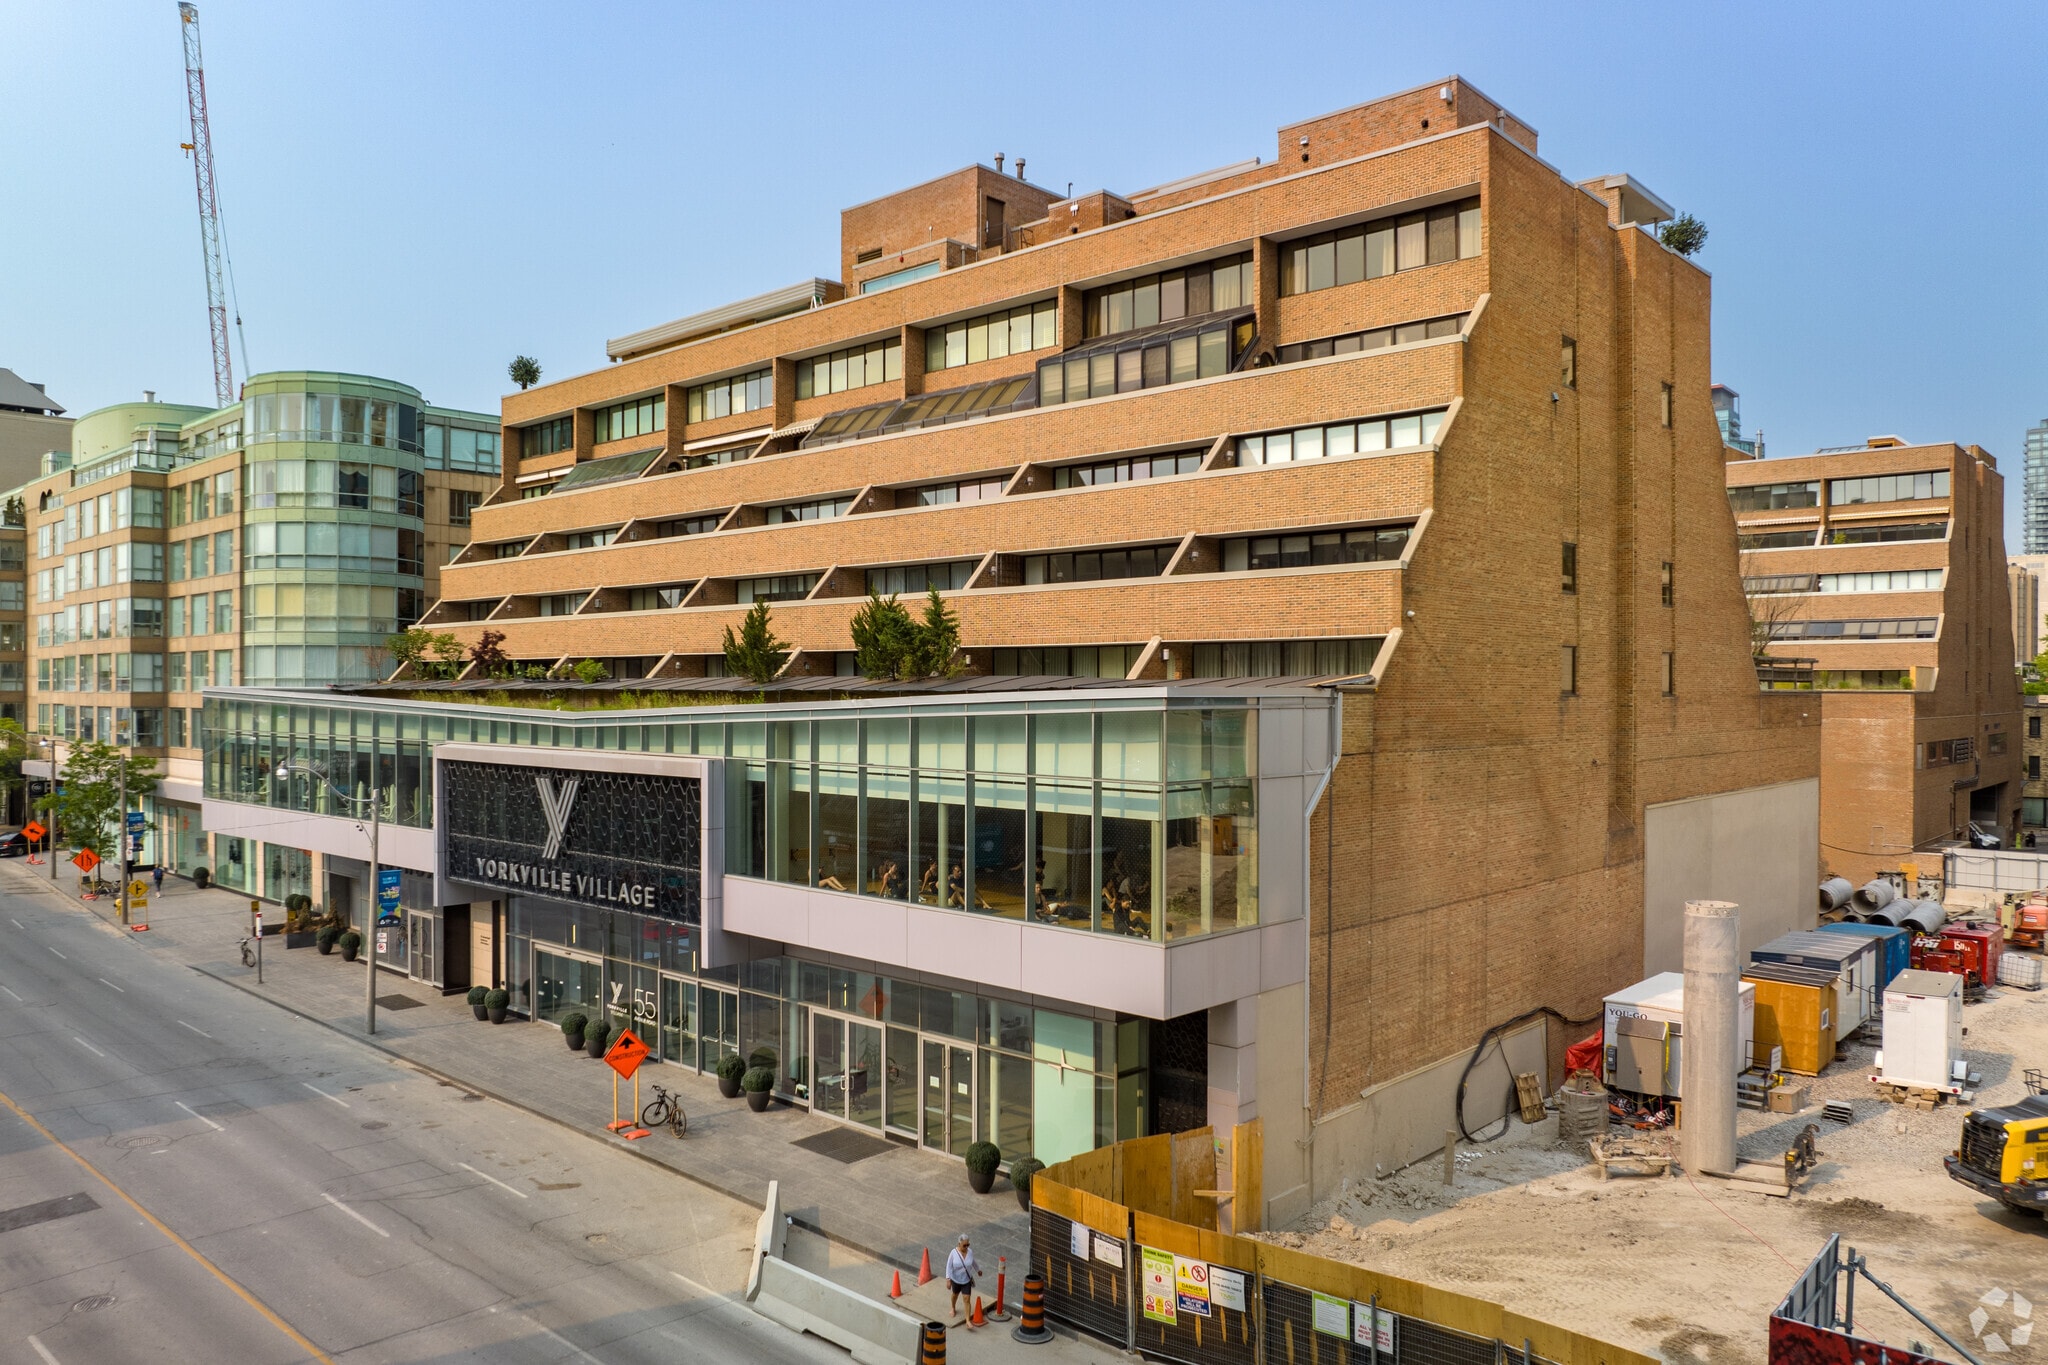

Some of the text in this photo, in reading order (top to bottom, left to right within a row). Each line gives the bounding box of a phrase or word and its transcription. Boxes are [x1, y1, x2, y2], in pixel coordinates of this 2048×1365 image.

[476, 857, 656, 908] YORKVILLE VILLAGE
[634, 988, 656, 1019] 55
[1609, 1008, 1648, 1020] YOU-GO
[608, 1049, 646, 1061] CONSTRUCTION
[1157, 1252, 1173, 1260] SAFETY
[1181, 1282, 1203, 1292] DANGER
[1180, 1303, 1208, 1314] PROSECUTED
